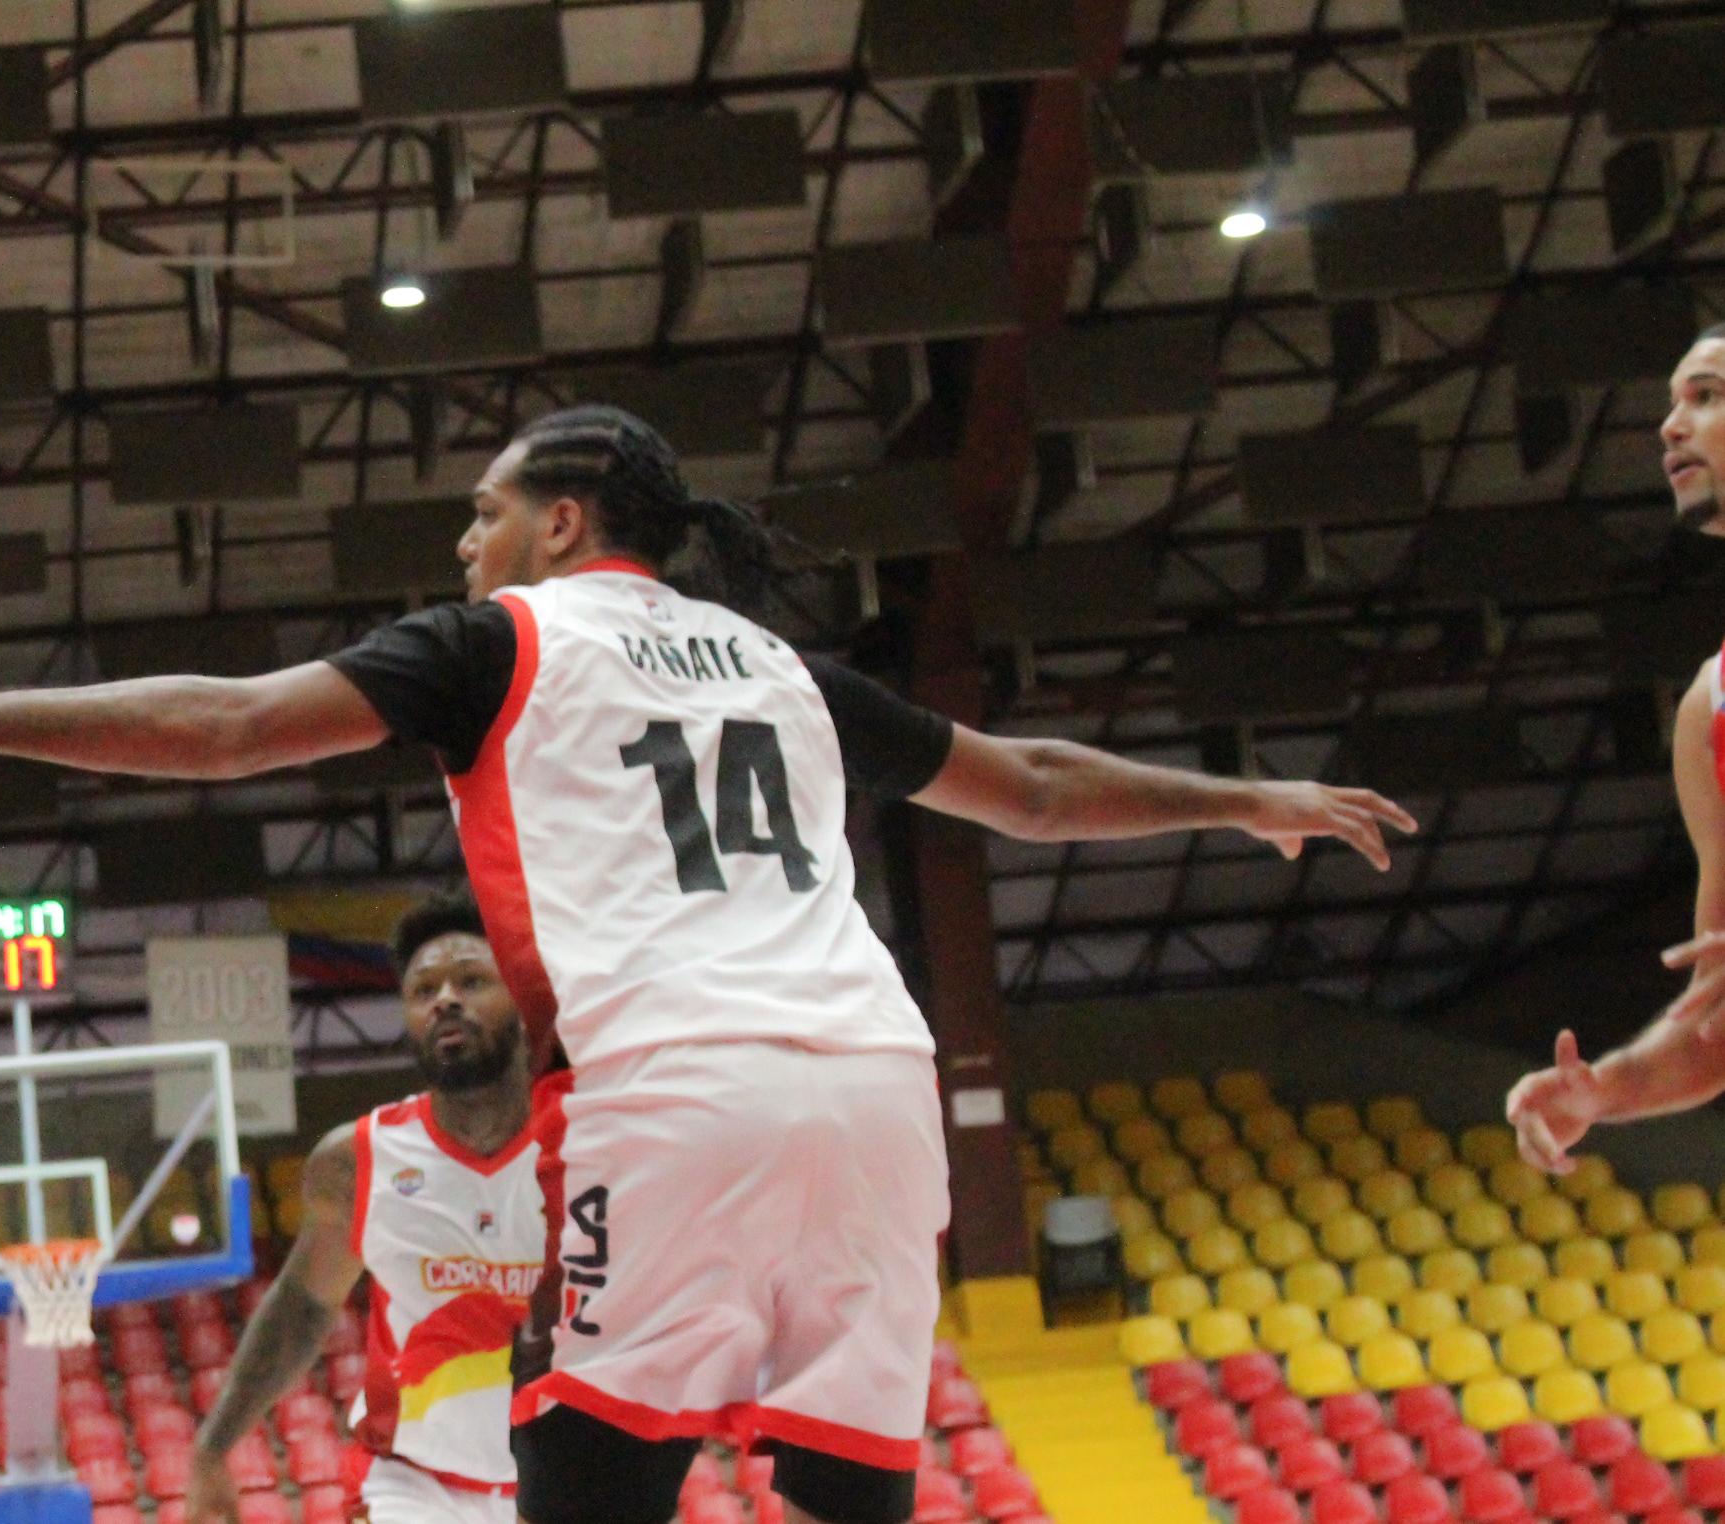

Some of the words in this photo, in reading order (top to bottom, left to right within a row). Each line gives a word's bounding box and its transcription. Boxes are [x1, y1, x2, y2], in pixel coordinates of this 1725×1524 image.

[619, 719, 821, 894] 14
[4, 934, 57, 991] 17
[563, 1184, 609, 1337] FILA
